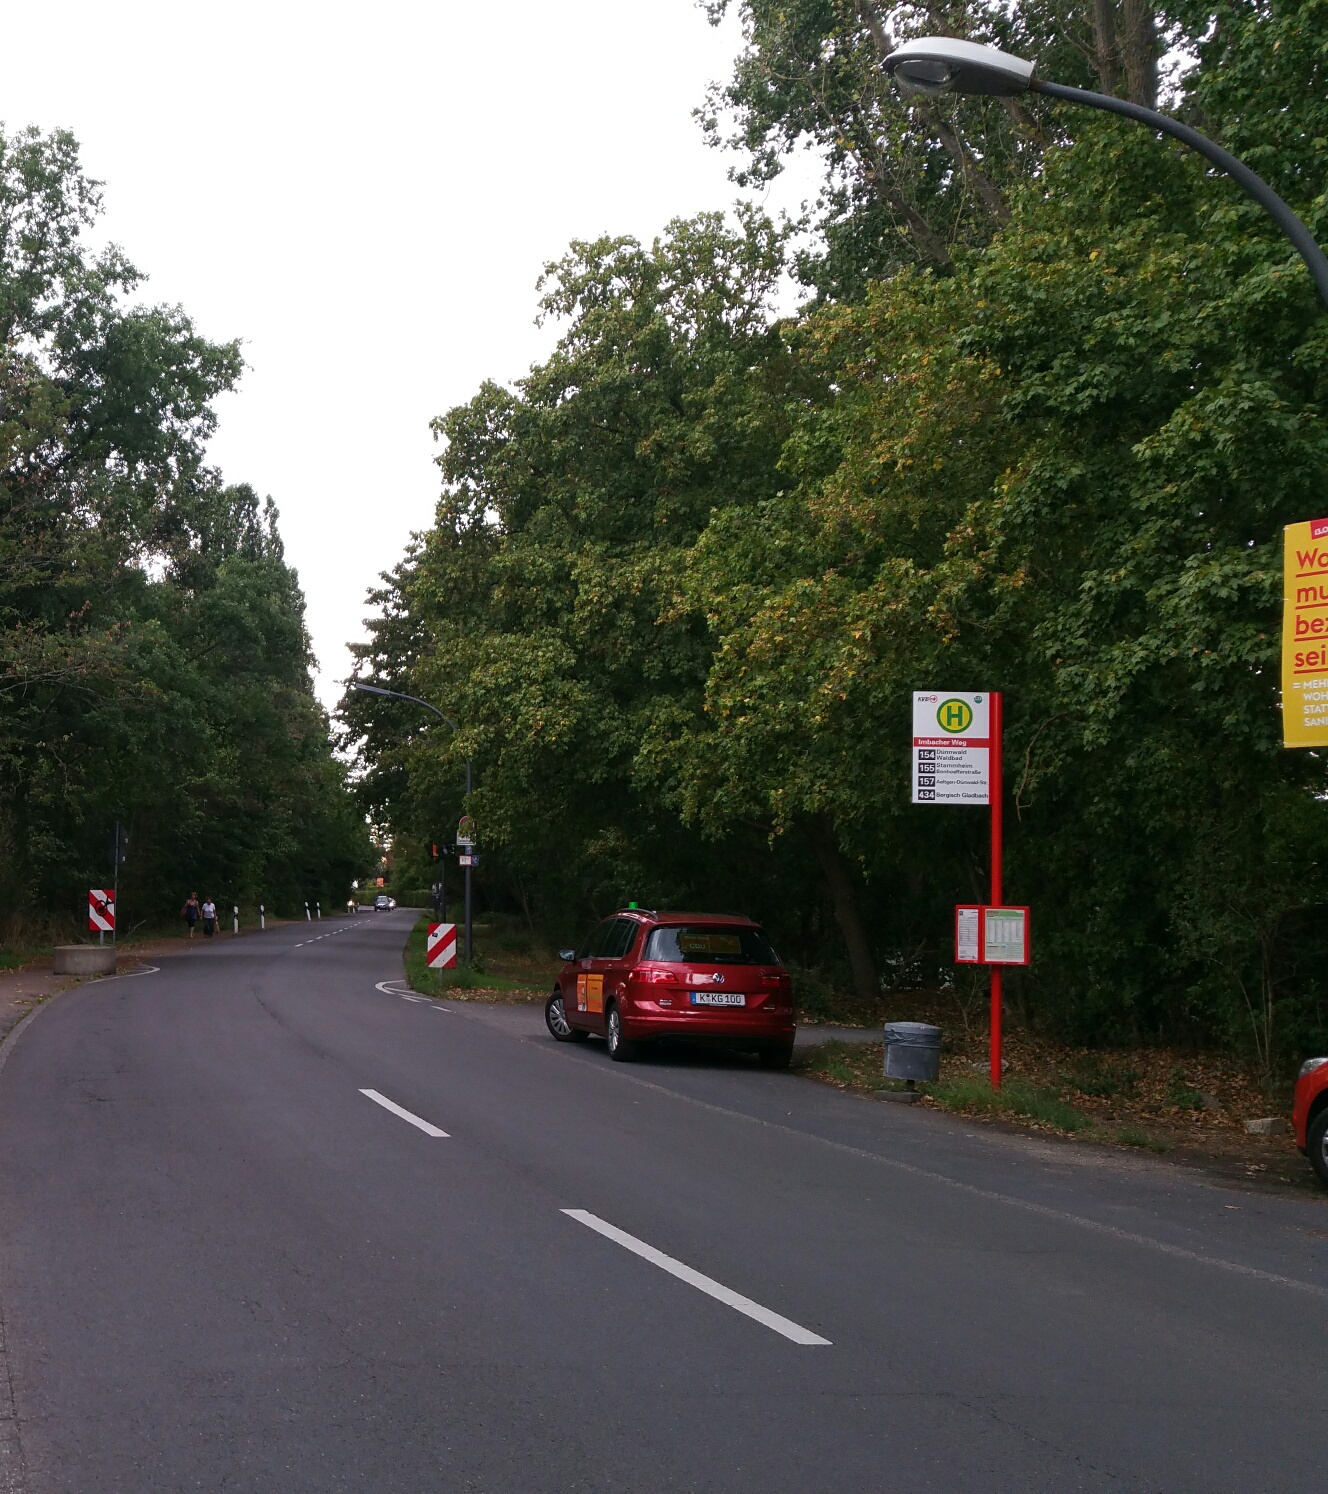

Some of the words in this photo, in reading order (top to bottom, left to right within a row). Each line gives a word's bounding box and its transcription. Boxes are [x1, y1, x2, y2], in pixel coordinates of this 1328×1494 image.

[1296, 547, 1328, 569] Wo
[1296, 585, 1328, 603] mu
[1294, 643, 1327, 668] sei
[1303, 679, 1328, 690] MEH
[946, 705, 963, 727] H
[951, 739, 967, 747] Weg
[919, 751, 935, 759] 154
[919, 764, 935, 772] 155
[919, 777, 935, 785] 157
[918, 790, 935, 799] 434
[711, 994, 724, 1003] KG
[725, 994, 742, 1004] 100
